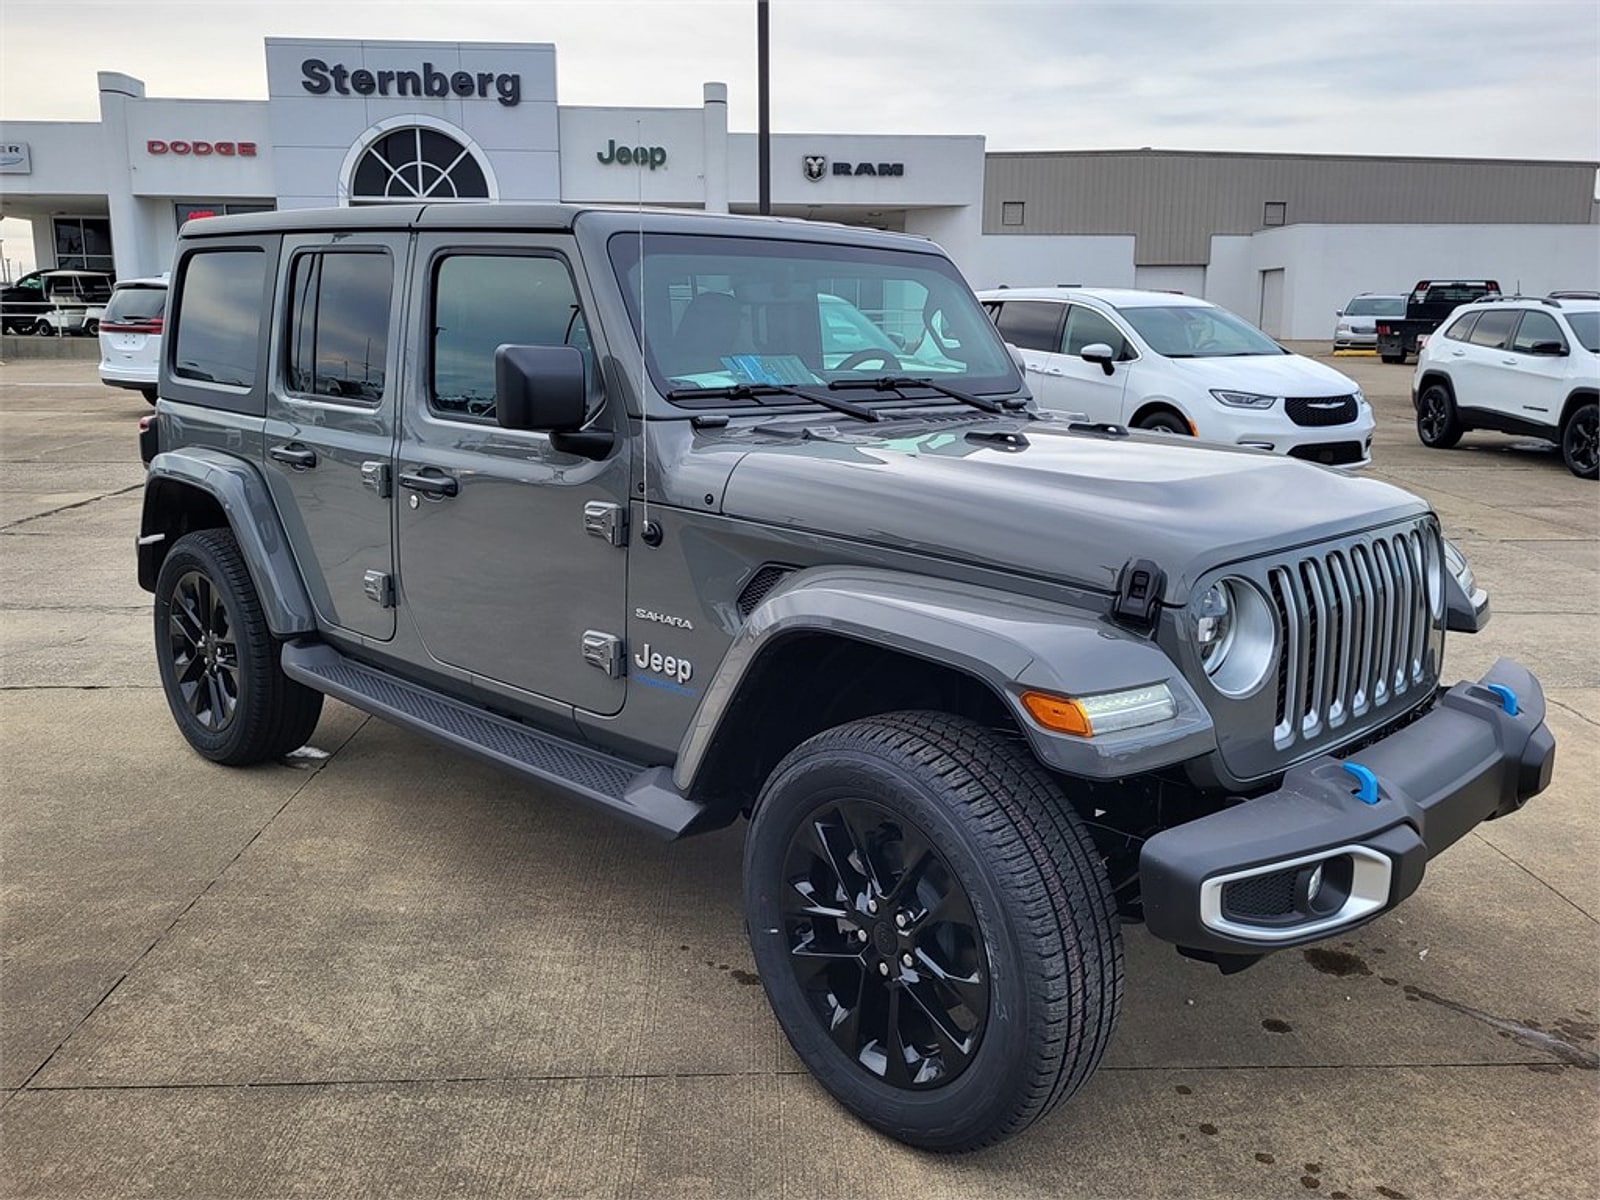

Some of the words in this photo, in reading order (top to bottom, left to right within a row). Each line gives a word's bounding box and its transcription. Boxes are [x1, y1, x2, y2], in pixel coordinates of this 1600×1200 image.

[301, 59, 522, 107] Sternberg
[147, 140, 256, 156] DODGE
[597, 139, 667, 171] Jeep
[832, 162, 904, 176] RAM
[635, 607, 694, 630] SAHARA
[634, 643, 692, 684] Jeep
